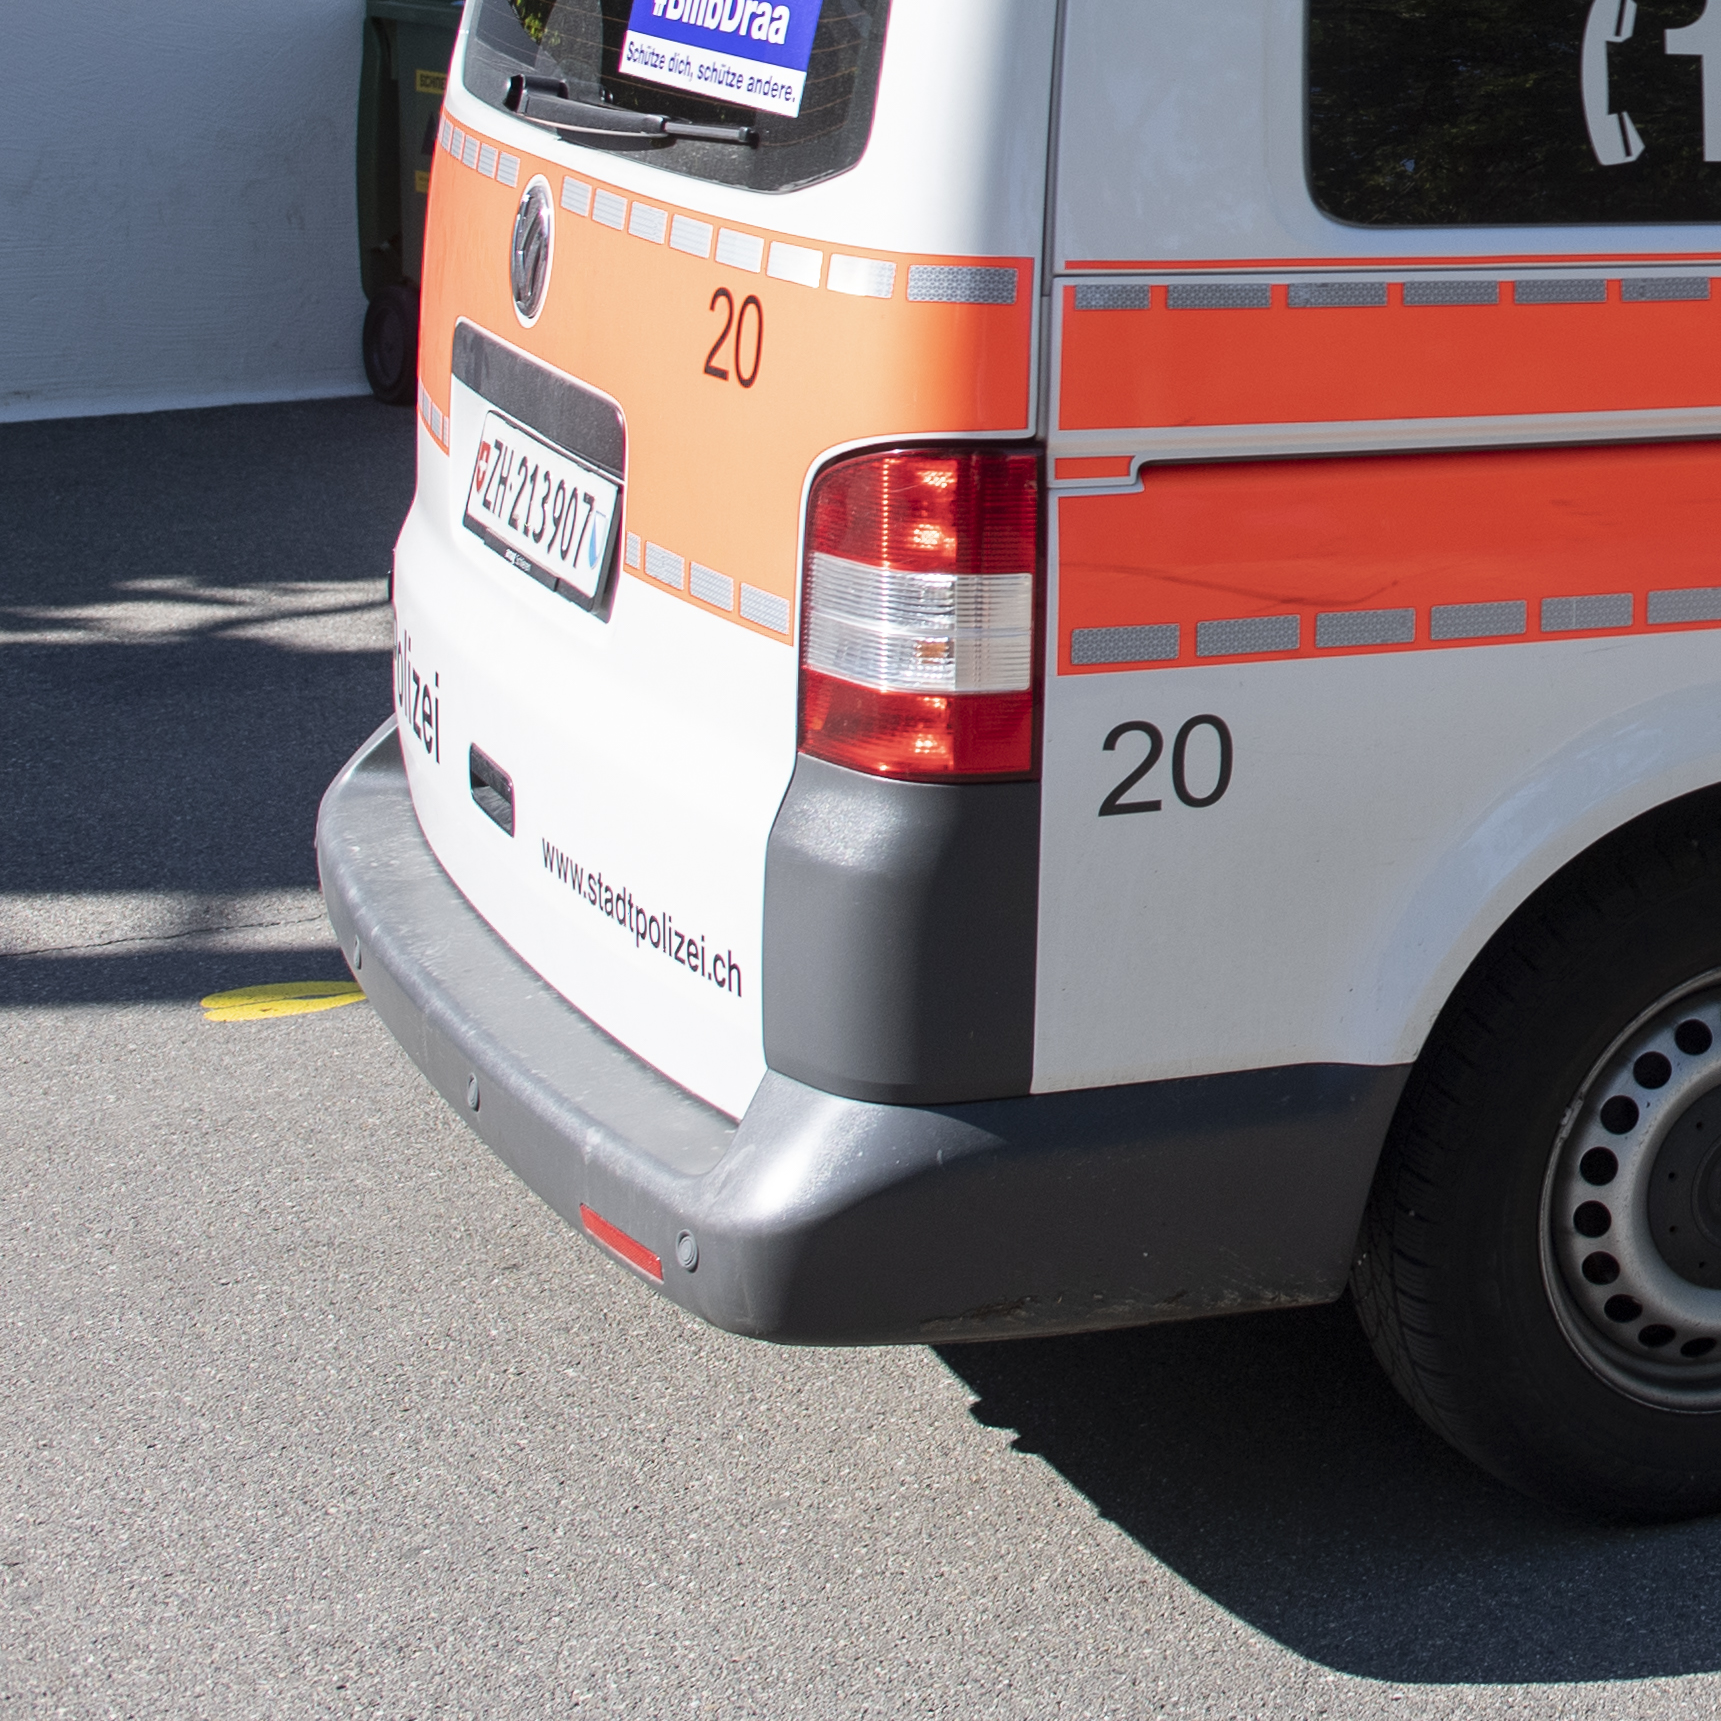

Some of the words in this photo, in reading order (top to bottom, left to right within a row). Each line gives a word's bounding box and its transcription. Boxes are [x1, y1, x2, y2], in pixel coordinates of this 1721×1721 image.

[626, 41, 666, 70] Schütze
[668, 52, 694, 82] dich,
[697, 63, 744, 90] schütze
[747, 77, 796, 103] andere.
[703, 286, 764, 389] 20
[1098, 714, 1233, 817] 20
[542, 837, 742, 998] www.stadtpolizei.ch
